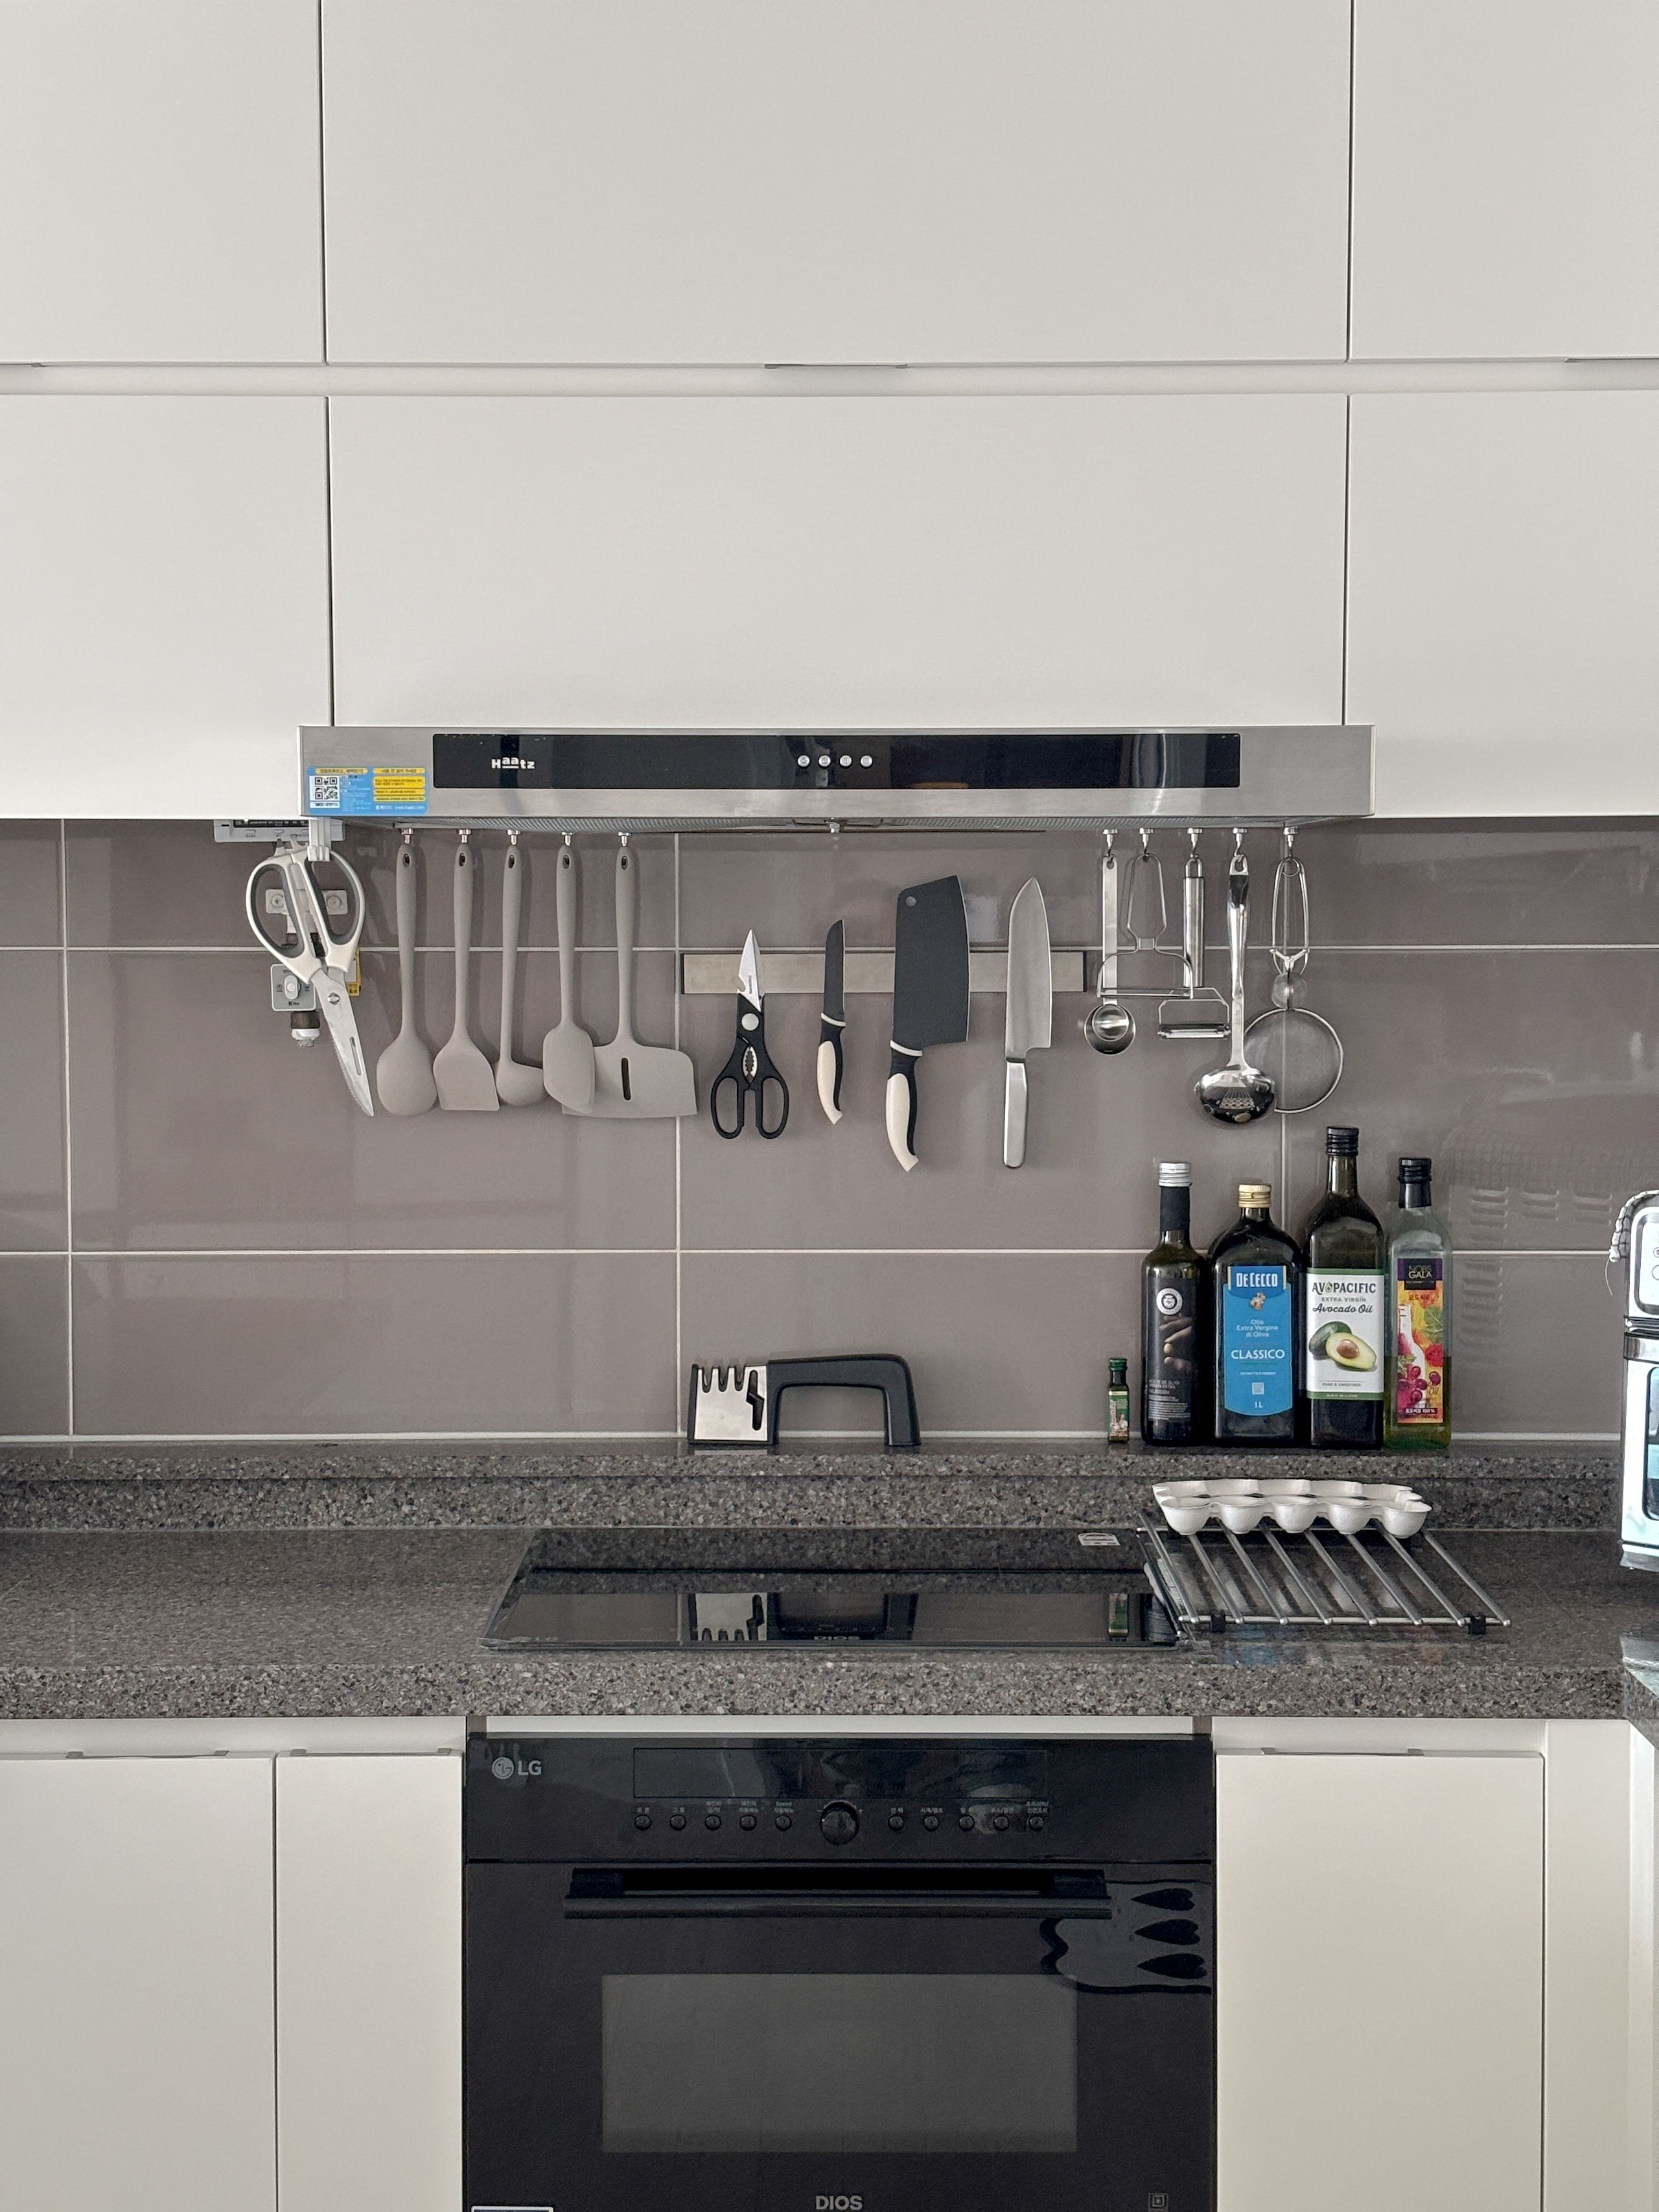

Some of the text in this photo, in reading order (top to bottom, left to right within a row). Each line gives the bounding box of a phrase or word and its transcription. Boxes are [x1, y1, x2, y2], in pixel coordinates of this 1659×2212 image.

[491, 757, 535, 769] Haatz
[1312, 1303, 1373, 1313] Avocado Oil
[1231, 1349, 1285, 1359] CLASSICO
[518, 1760, 542, 1775] LG
[816, 2195, 863, 2210] DIOS
